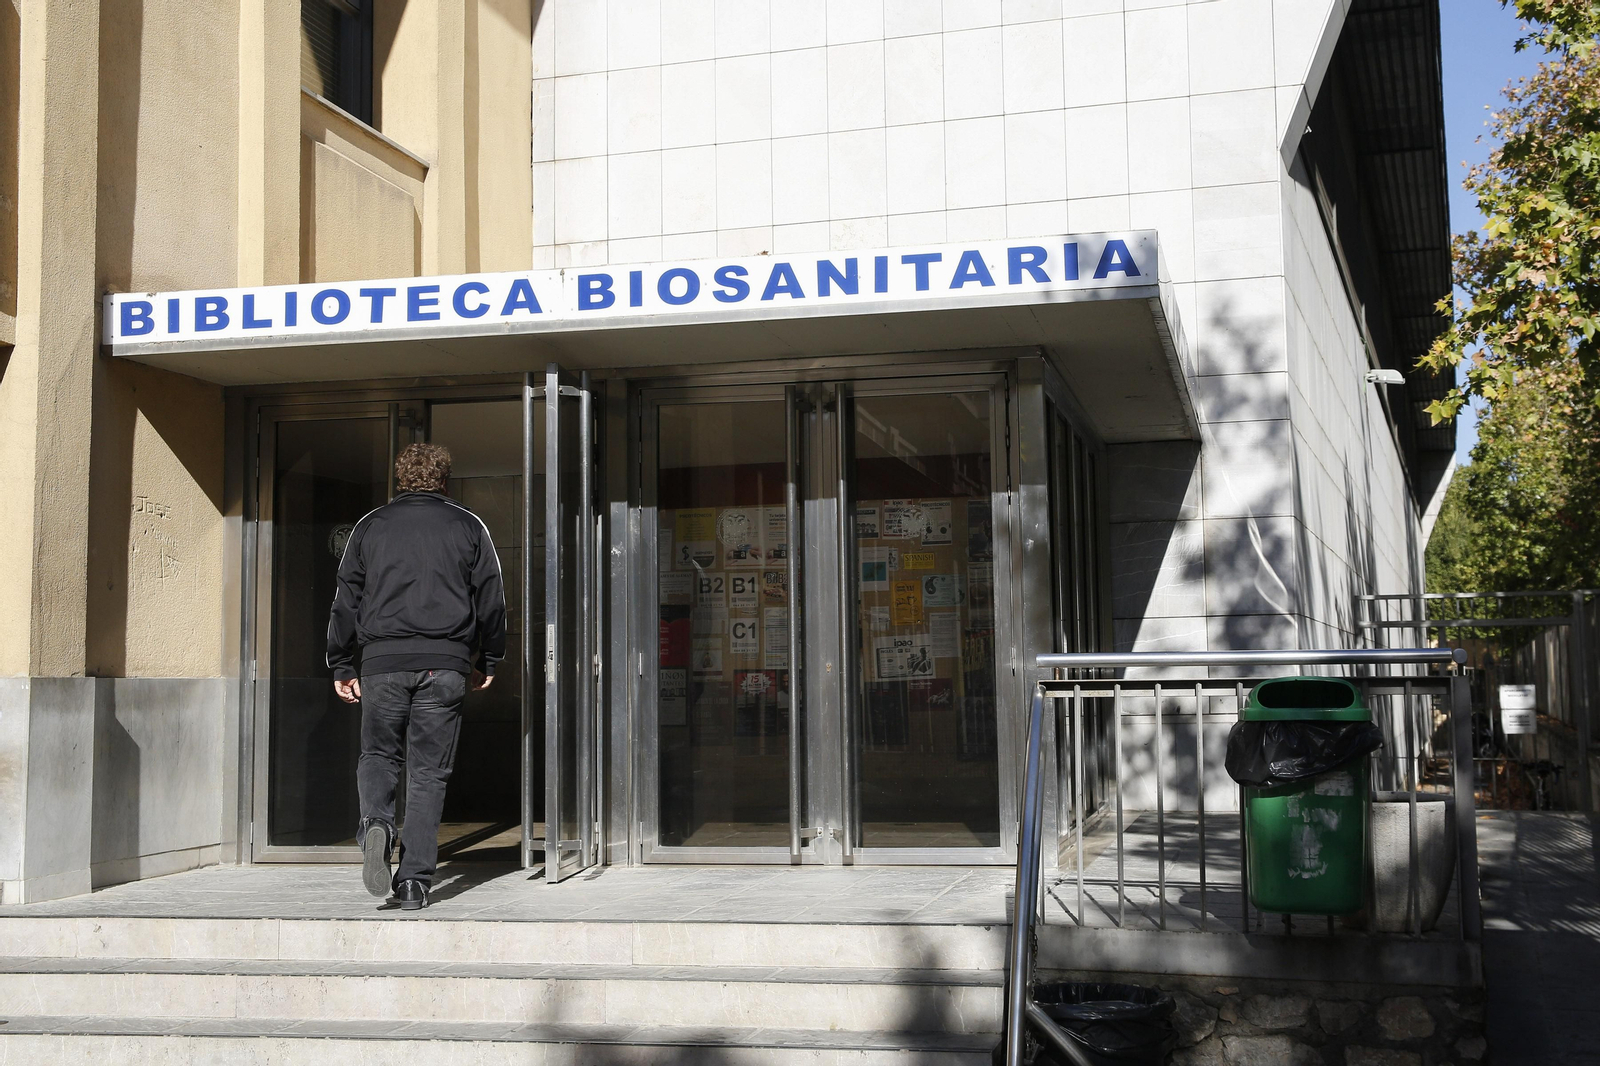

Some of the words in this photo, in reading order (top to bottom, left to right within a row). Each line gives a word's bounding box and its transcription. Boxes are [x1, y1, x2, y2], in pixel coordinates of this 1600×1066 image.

[120, 279, 543, 337] BIBLIOTECA
[577, 239, 1141, 311] BIOSANITARIA
[904, 554, 934, 562] SPANISH
[699, 577, 724, 594] B2
[732, 576, 756, 594] B1
[732, 622, 756, 639] C1
[893, 638, 913, 648] ipao
